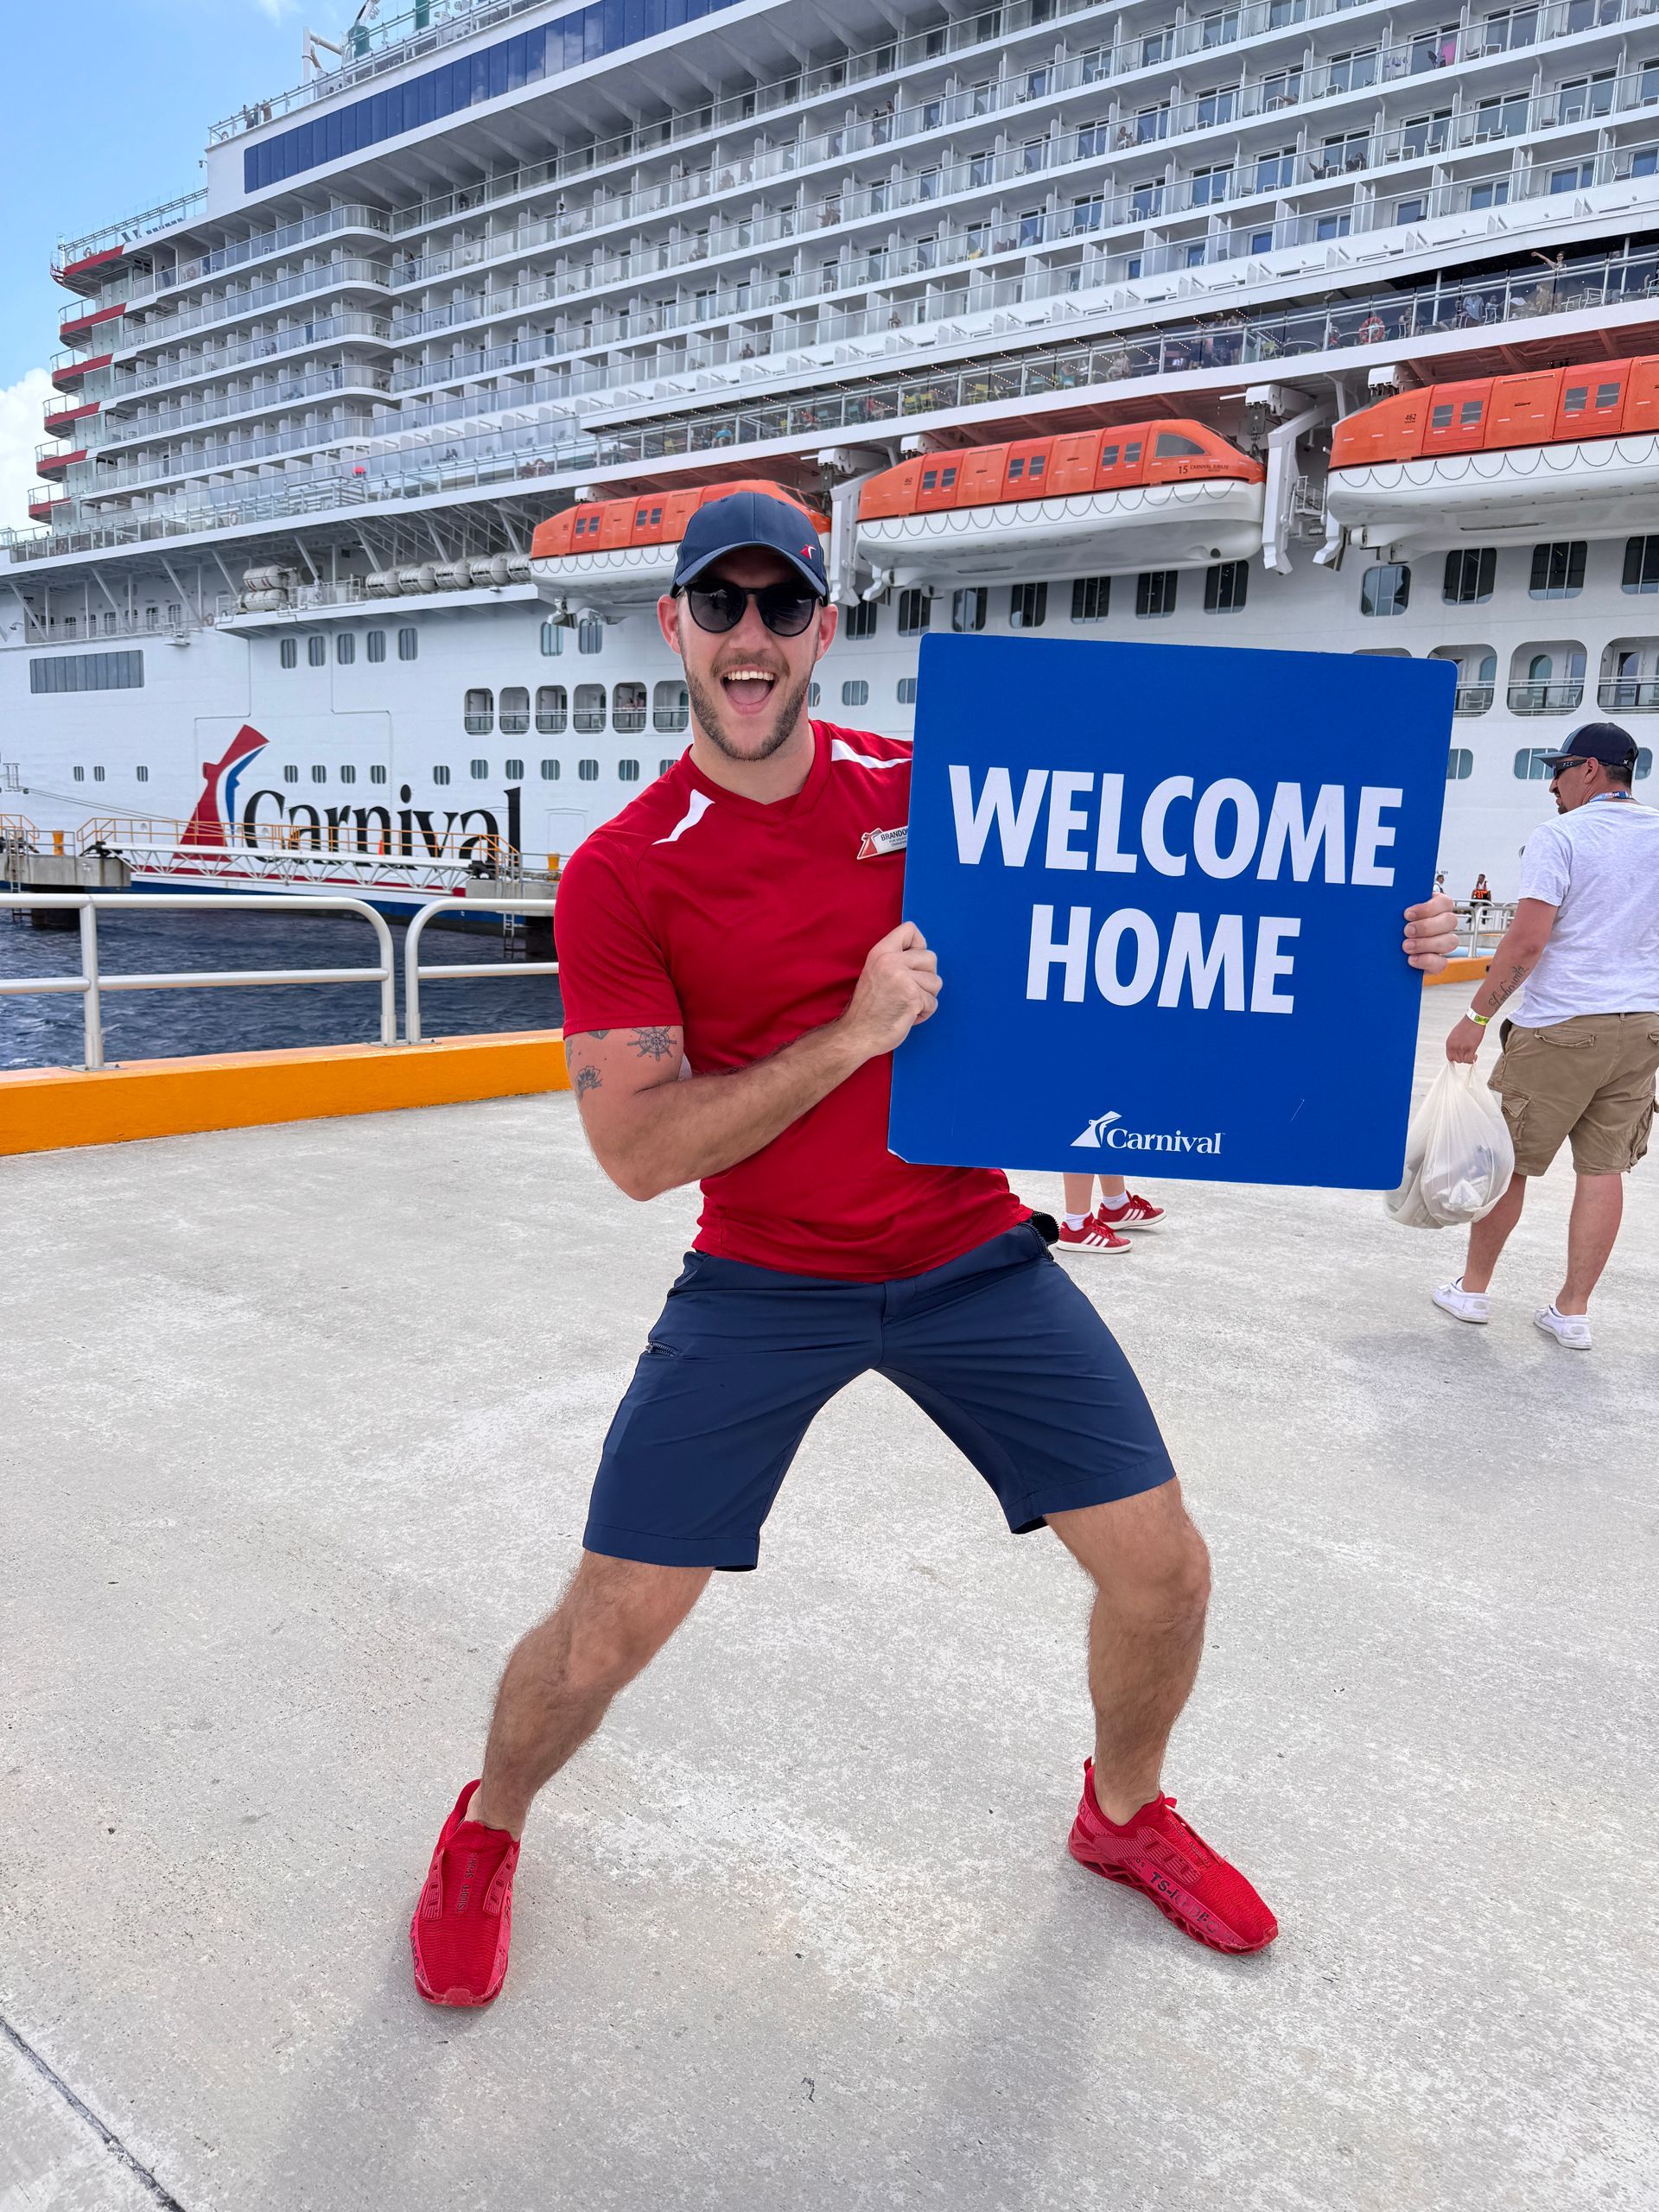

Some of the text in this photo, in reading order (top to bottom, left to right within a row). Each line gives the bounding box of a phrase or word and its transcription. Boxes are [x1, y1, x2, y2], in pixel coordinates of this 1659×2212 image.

[1179, 466, 1189, 474] 15
[243, 783, 522, 871] Carnival
[880, 828, 908, 842] BRANDO
[948, 765, 1403, 887] WELCOME
[1026, 904, 1301, 1014] HOME
[1106, 1128, 1222, 1155] Carnival
